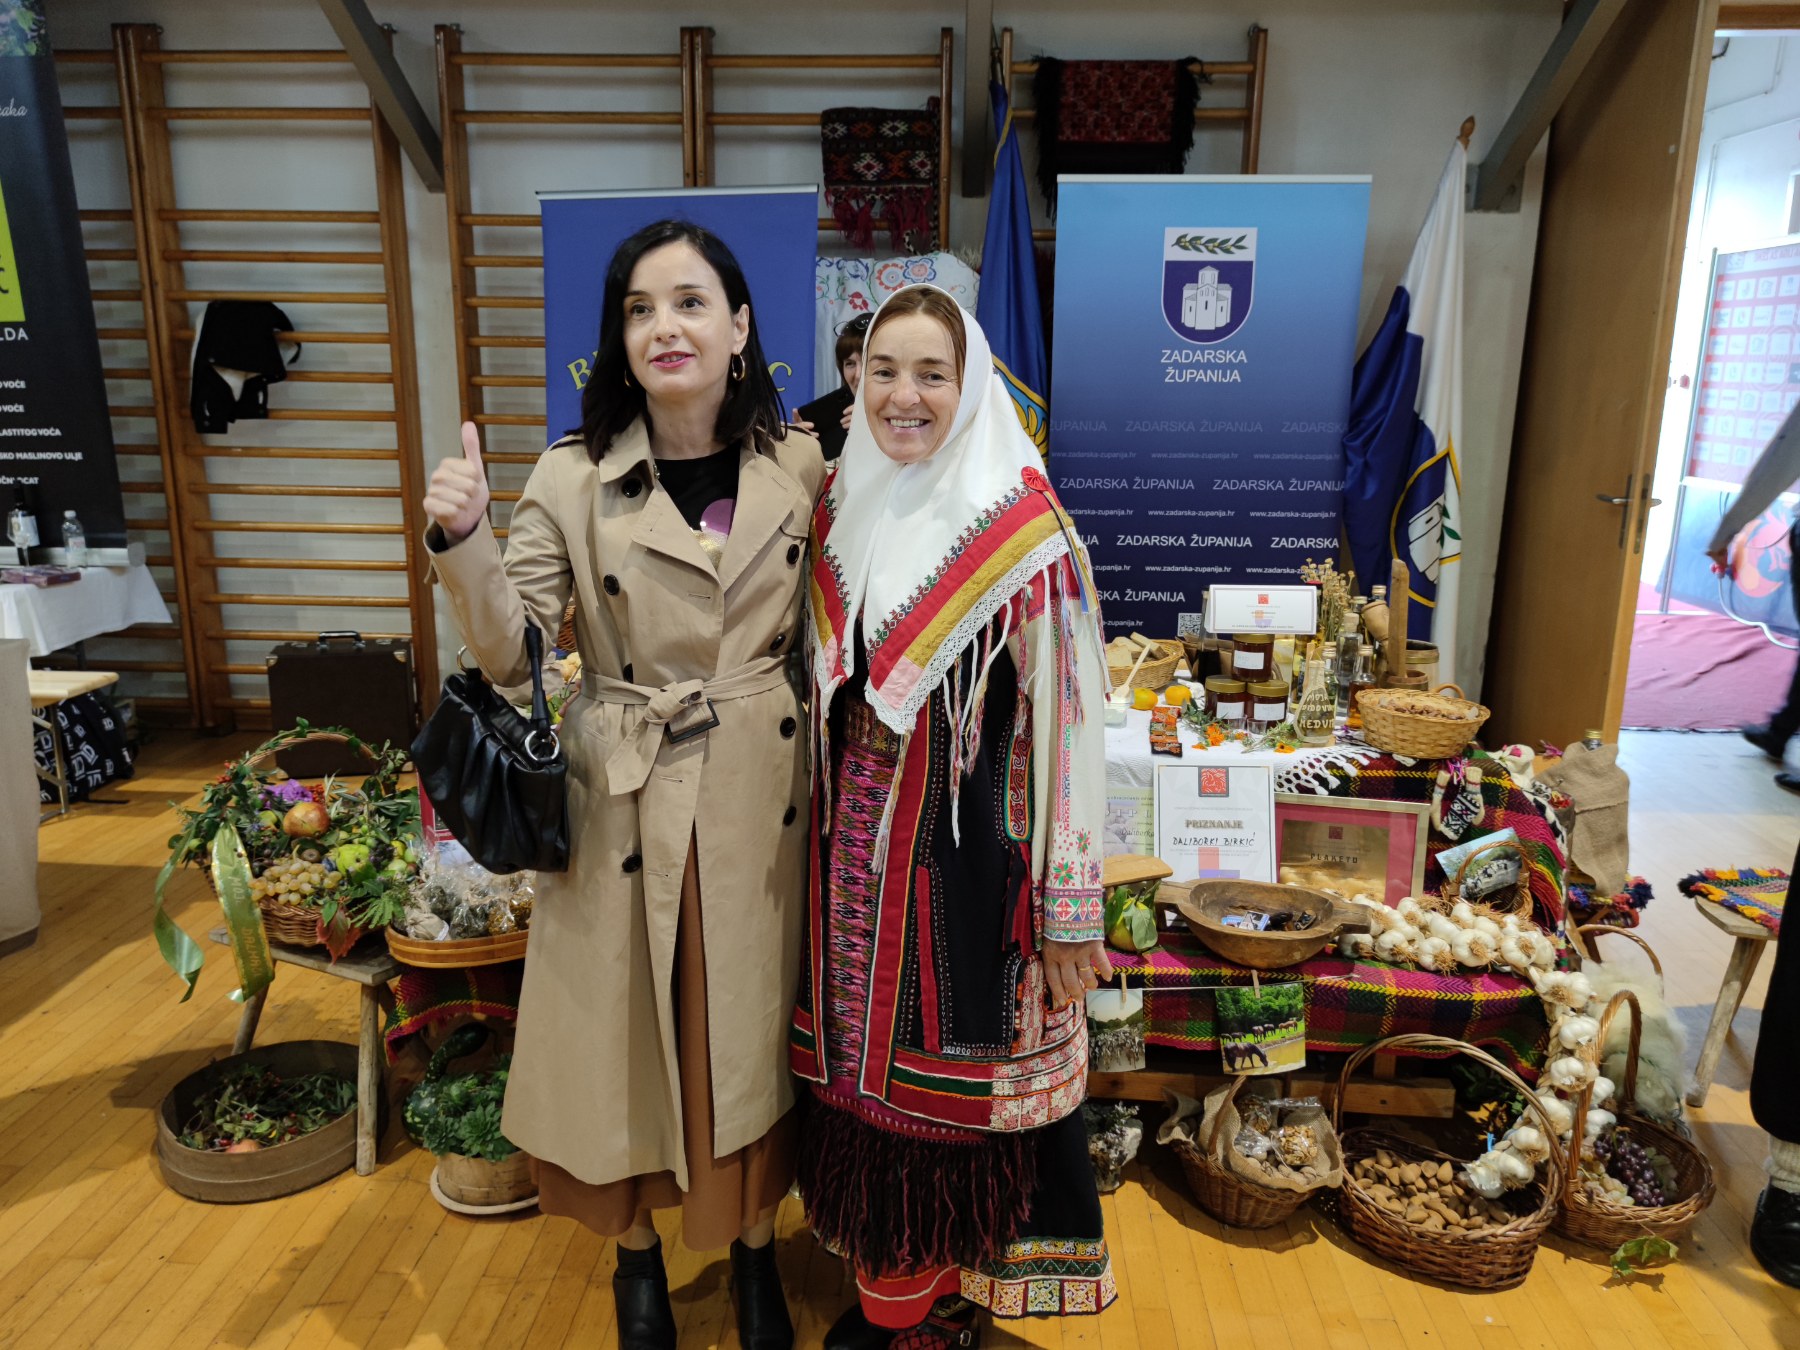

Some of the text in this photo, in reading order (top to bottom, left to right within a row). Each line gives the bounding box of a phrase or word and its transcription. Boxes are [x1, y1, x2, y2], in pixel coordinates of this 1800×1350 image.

[1160, 349, 1247, 364] ZADARSKA
[1164, 366, 1241, 383] ŽUPANIJA
[1125, 420, 1195, 433] ZADARSKA
[1199, 419, 1263, 433] ŽUPANIJA
[1151, 451, 1239, 461] www.zadarska-zupanija.hr
[1060, 477, 1128, 490] ZADARSKA
[1132, 475, 1195, 490] ŽUPANIJA
[1213, 478, 1284, 491] ZADARSKA
[1148, 508, 1235, 518] www.zadarska-zupanija.hr
[1250, 509, 1336, 519] www.zadarska-zupanija.hr
[1116, 535, 1186, 547] ZADARSKA
[1190, 533, 1253, 548] ŽUPANIJA
[1270, 536, 1339, 549] ZADARSKA
[1145, 564, 1232, 574] www.zadarska-zupanija.hr
[1124, 588, 1186, 602] ŽUPANIJA
[1184, 819, 1244, 829] PRIZNANJE
[1172, 831, 1256, 847] DALIBORKI BIRKIĆ
